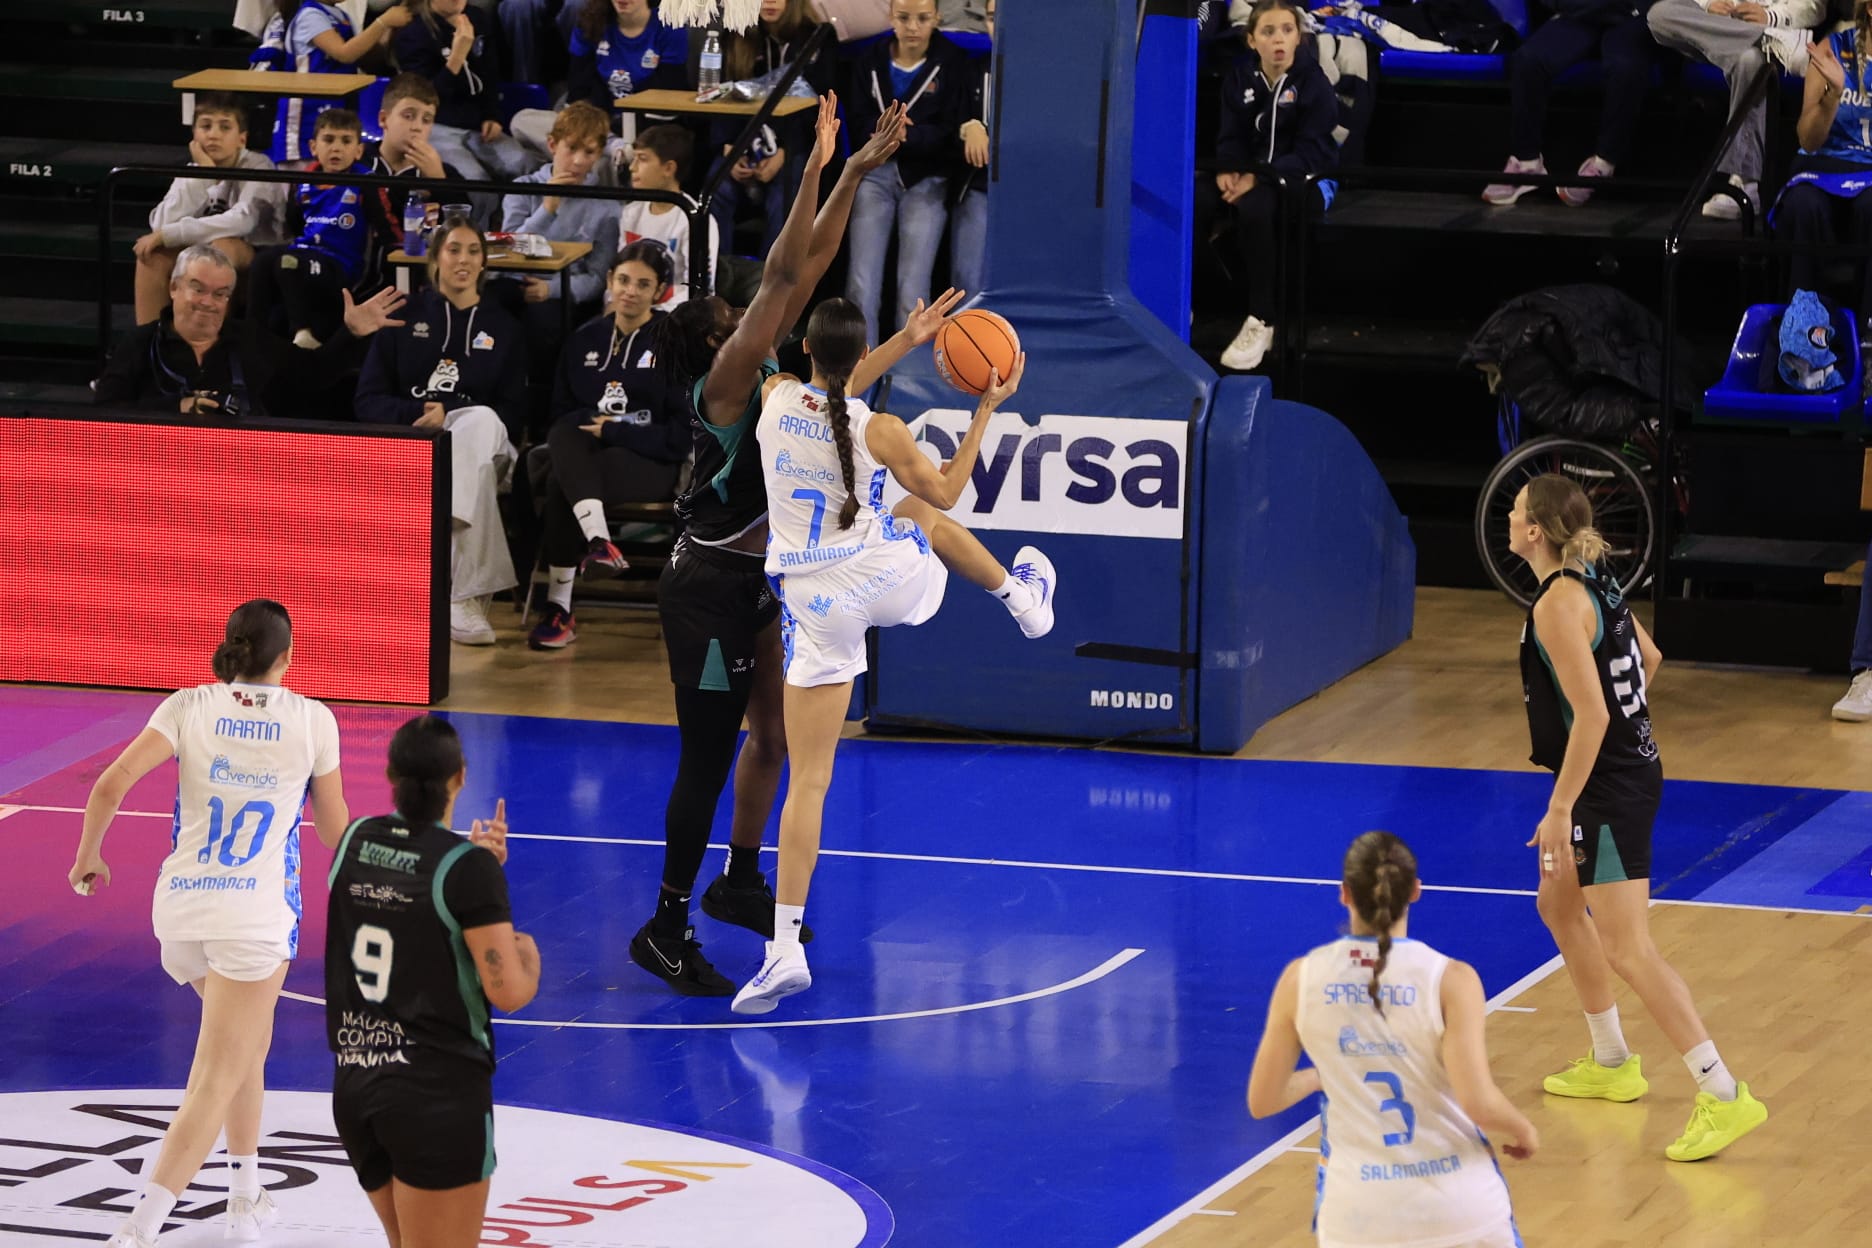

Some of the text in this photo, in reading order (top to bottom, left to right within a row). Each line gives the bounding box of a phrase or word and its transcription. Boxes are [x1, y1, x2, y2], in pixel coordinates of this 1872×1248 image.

[103, 10, 145, 23] FILA 3
[10, 163, 53, 177] FILA 2
[779, 414, 834, 443] ARROJO
[791, 488, 826, 549] 7
[1090, 690, 1173, 710] MONDO
[197, 796, 275, 867] 10
[351, 923, 394, 1003] 9
[1324, 983, 1417, 1006] SPREFICO
[1364, 1071, 1416, 1147] 3
[1360, 1154, 1462, 1181] SALAMANCA
